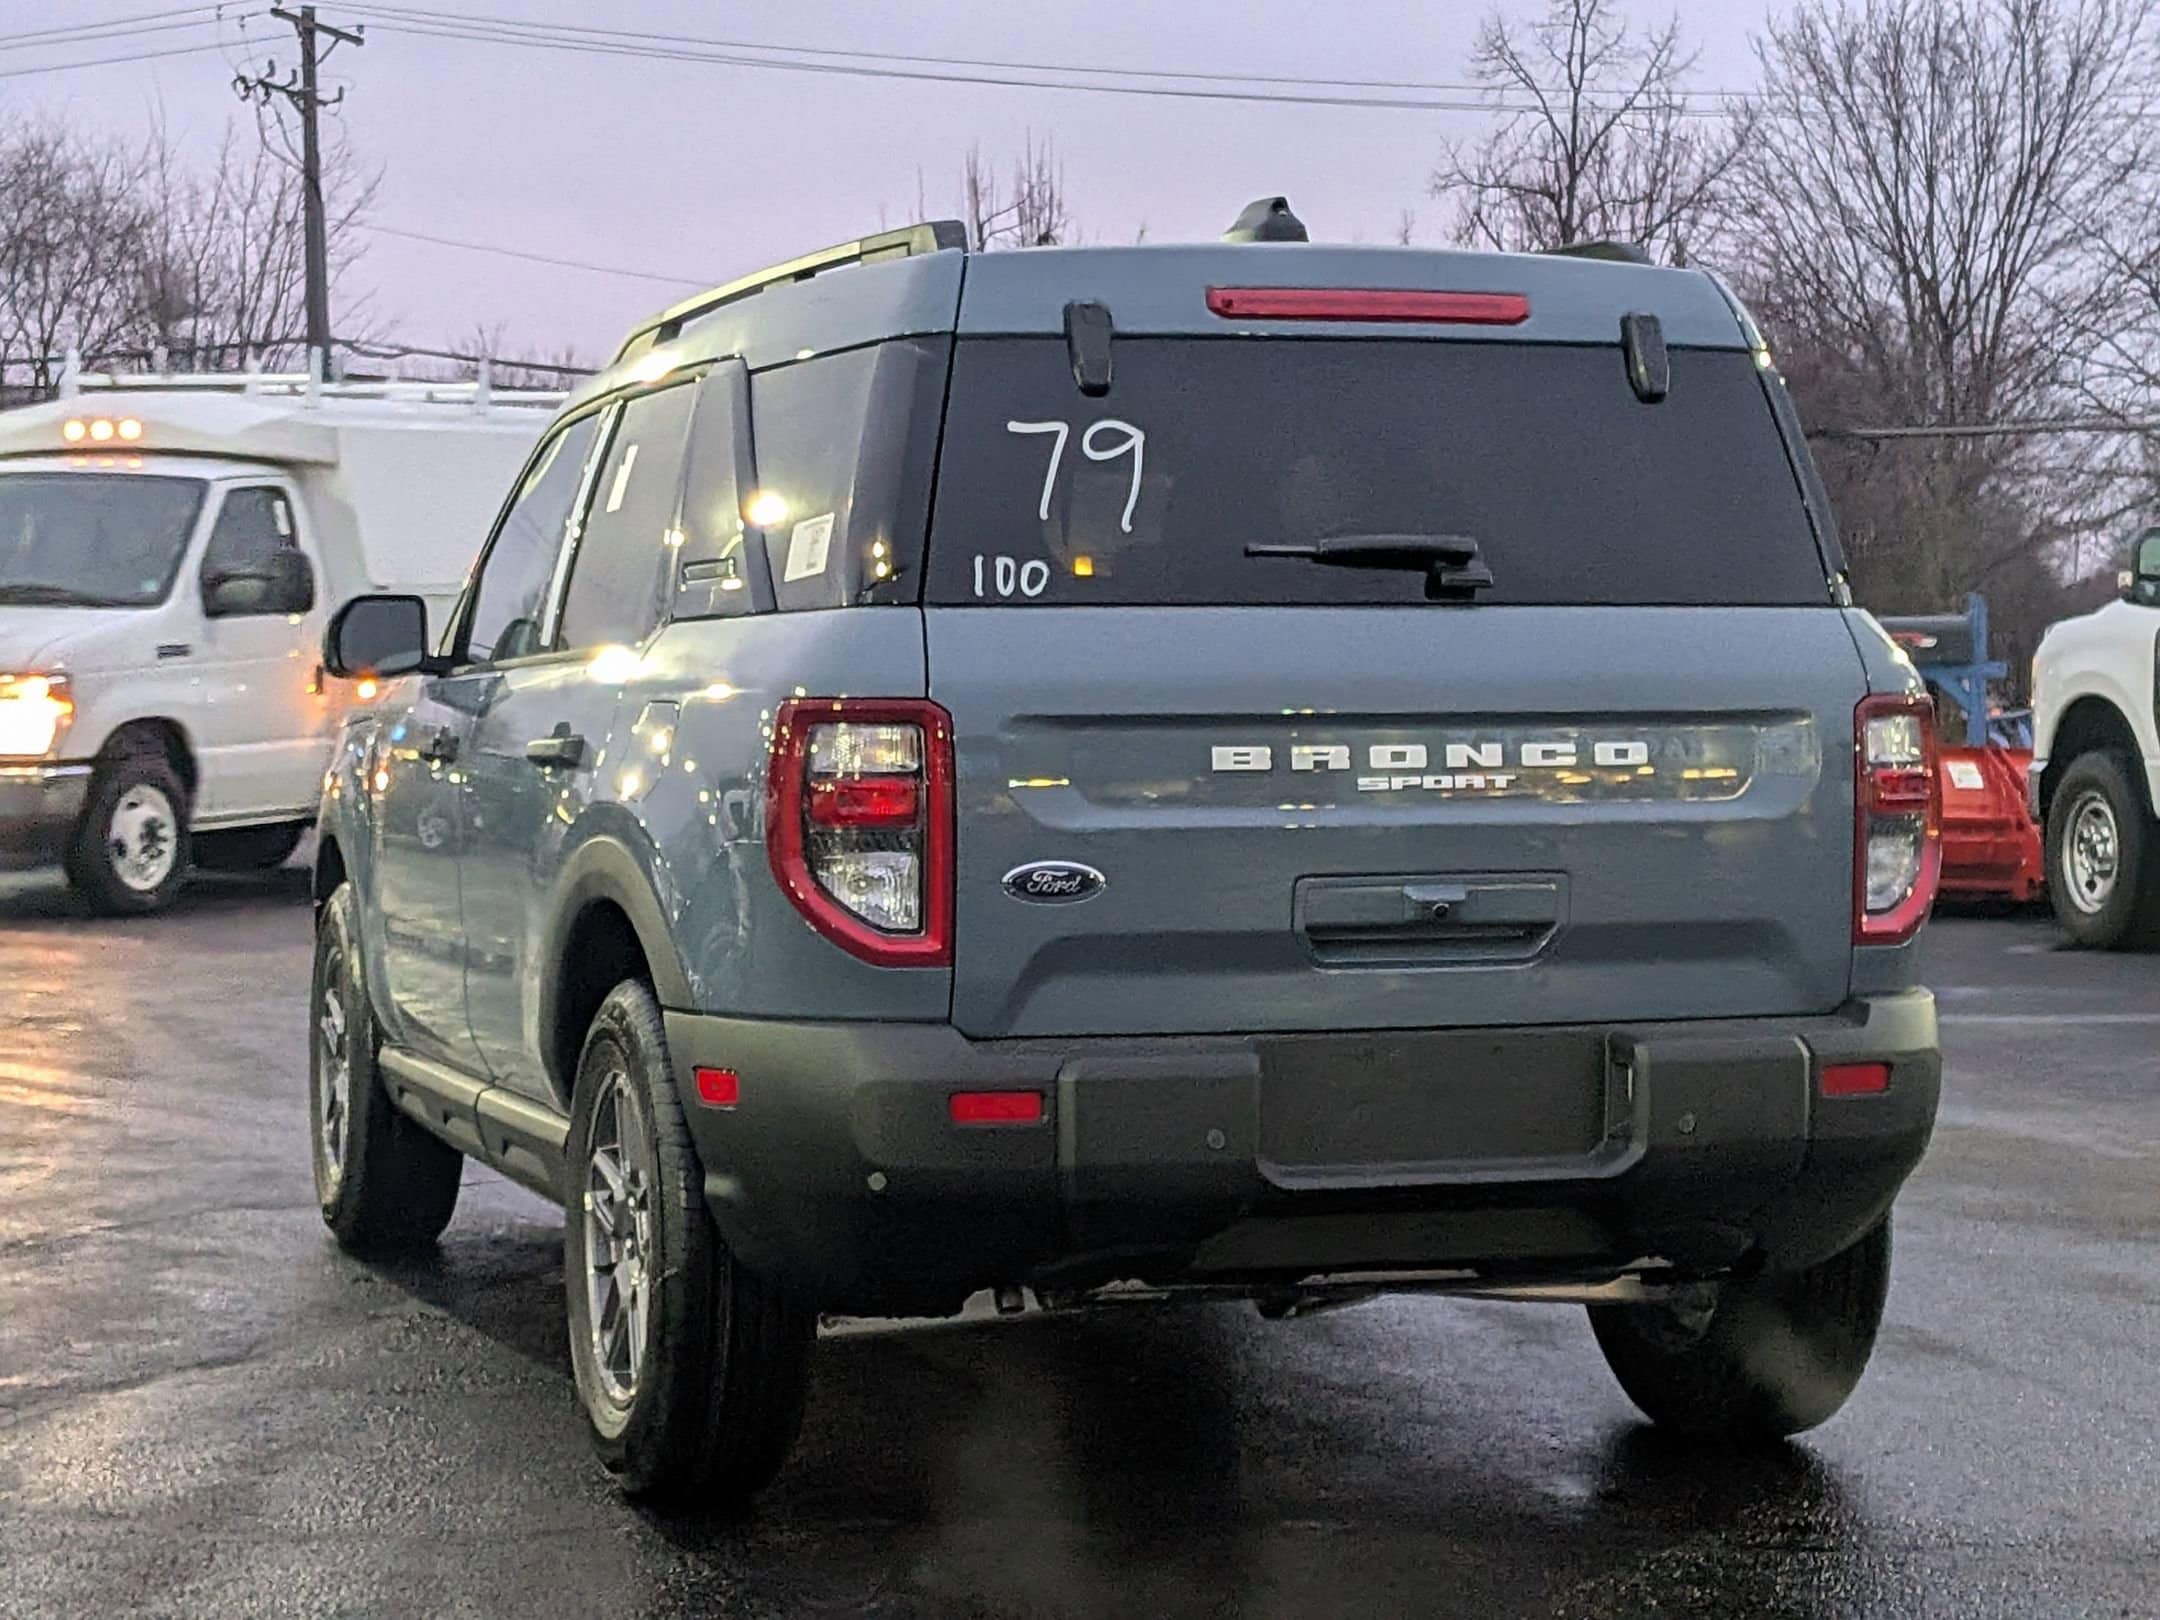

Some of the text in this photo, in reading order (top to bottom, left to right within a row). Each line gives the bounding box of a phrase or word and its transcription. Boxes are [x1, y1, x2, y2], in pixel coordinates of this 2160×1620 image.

[1007, 420, 1145, 532] 79
[974, 555, 1049, 596] 100
[1211, 741, 1649, 772] BRONCO
[1357, 774, 1517, 792] SPORT
[1027, 870, 1081, 893] Ford
